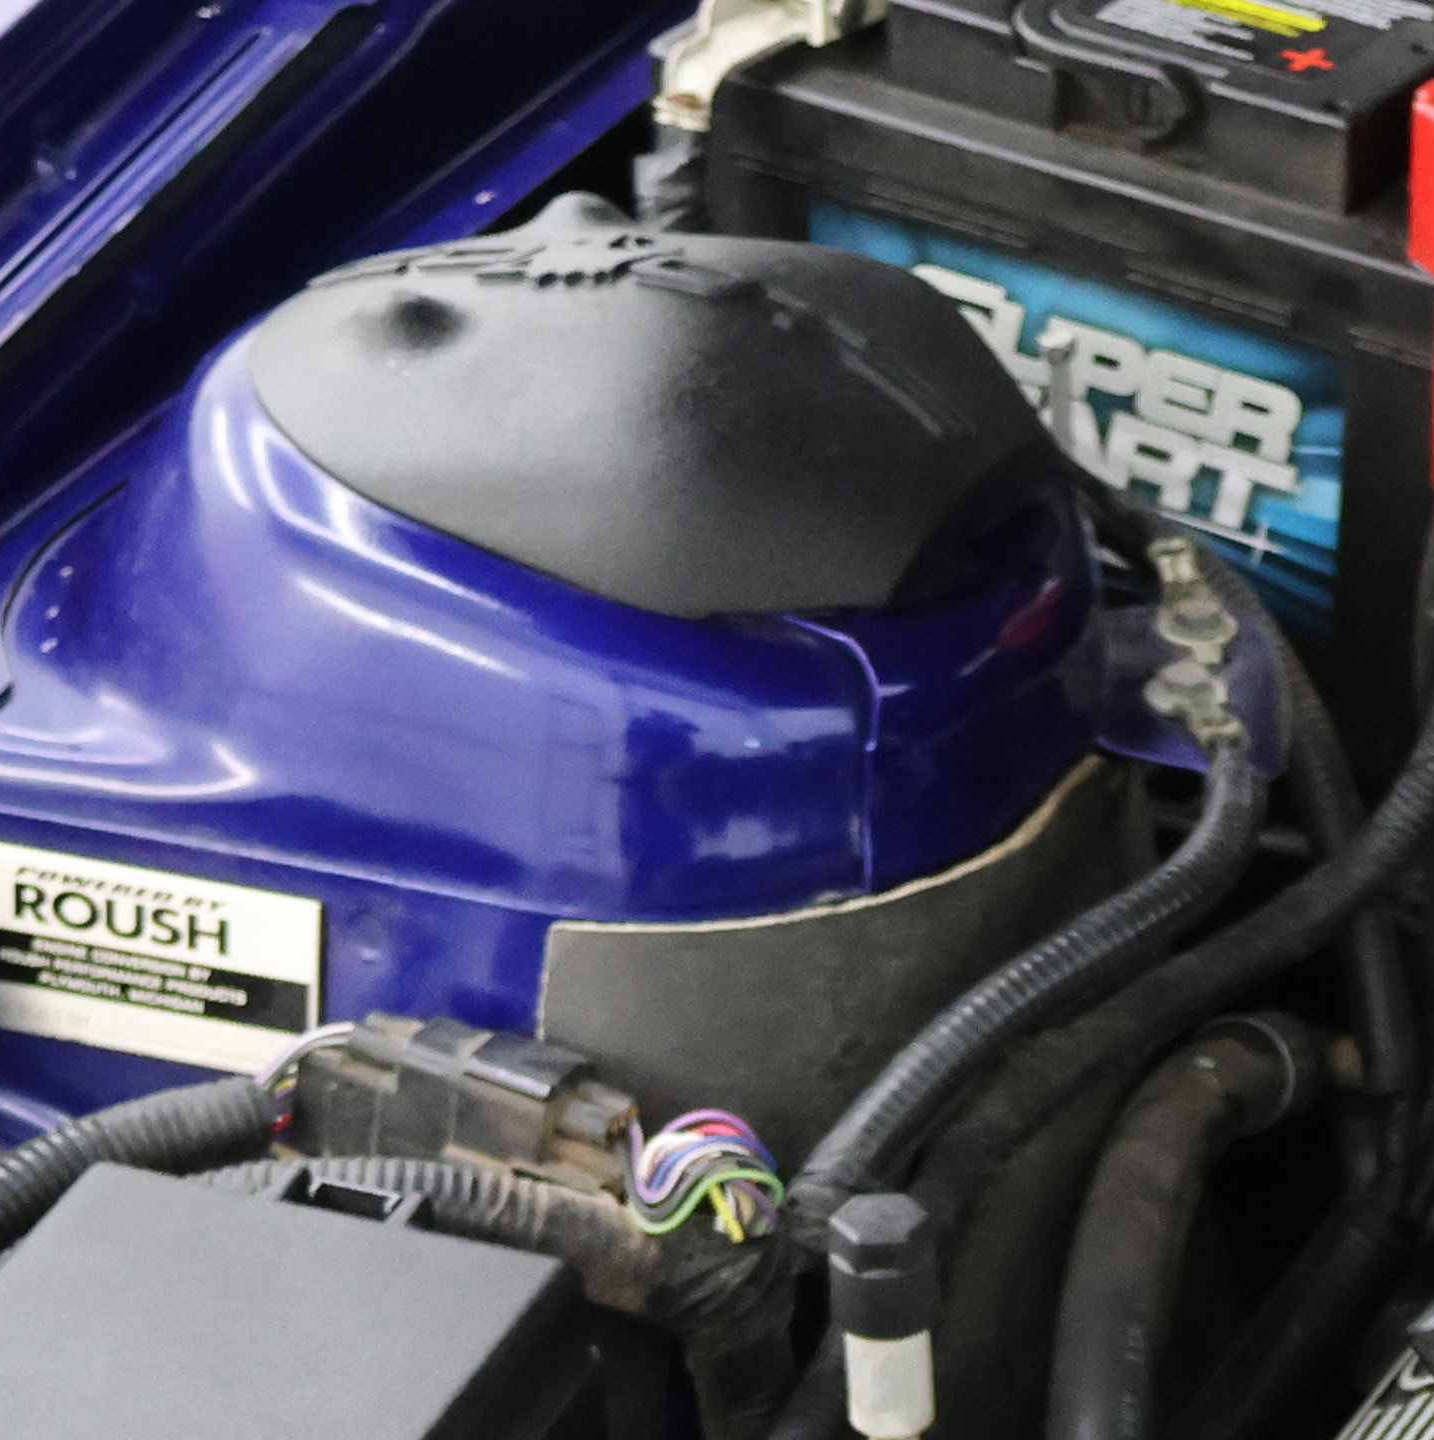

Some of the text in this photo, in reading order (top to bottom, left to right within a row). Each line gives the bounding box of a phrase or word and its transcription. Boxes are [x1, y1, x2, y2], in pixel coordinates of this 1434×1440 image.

[1024, 385, 1303, 530] ART
[14, 882, 229, 955] ROUSH
[17, 866, 174, 902] POWERED
